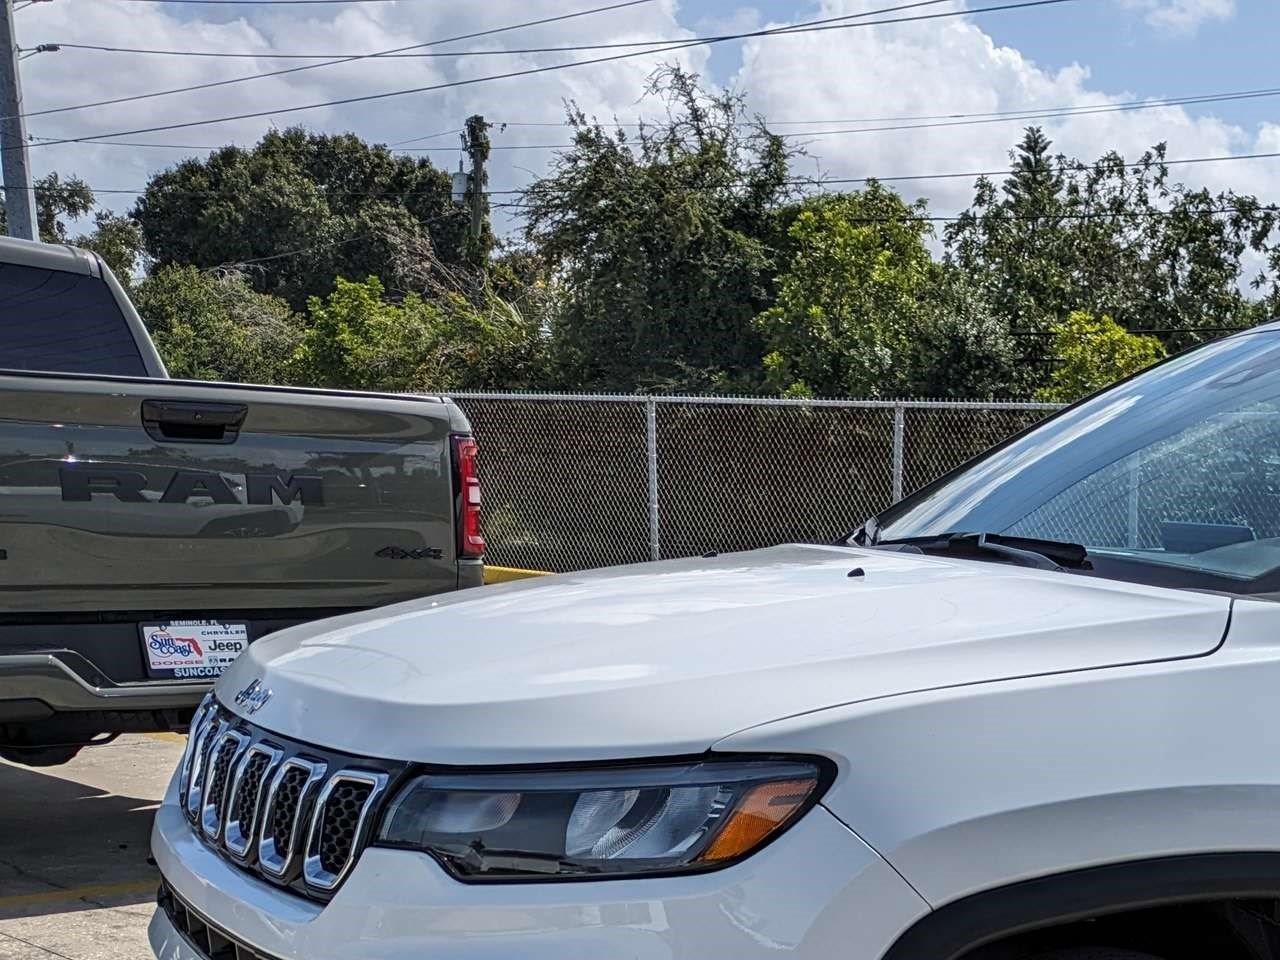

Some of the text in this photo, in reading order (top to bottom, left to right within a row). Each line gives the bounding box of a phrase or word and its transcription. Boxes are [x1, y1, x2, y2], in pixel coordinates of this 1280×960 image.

[59, 468, 323, 507] RAM
[150, 635, 176, 650] Sun
[208, 640, 243, 653] Jeep
[174, 667, 227, 677] SUNCOAS
